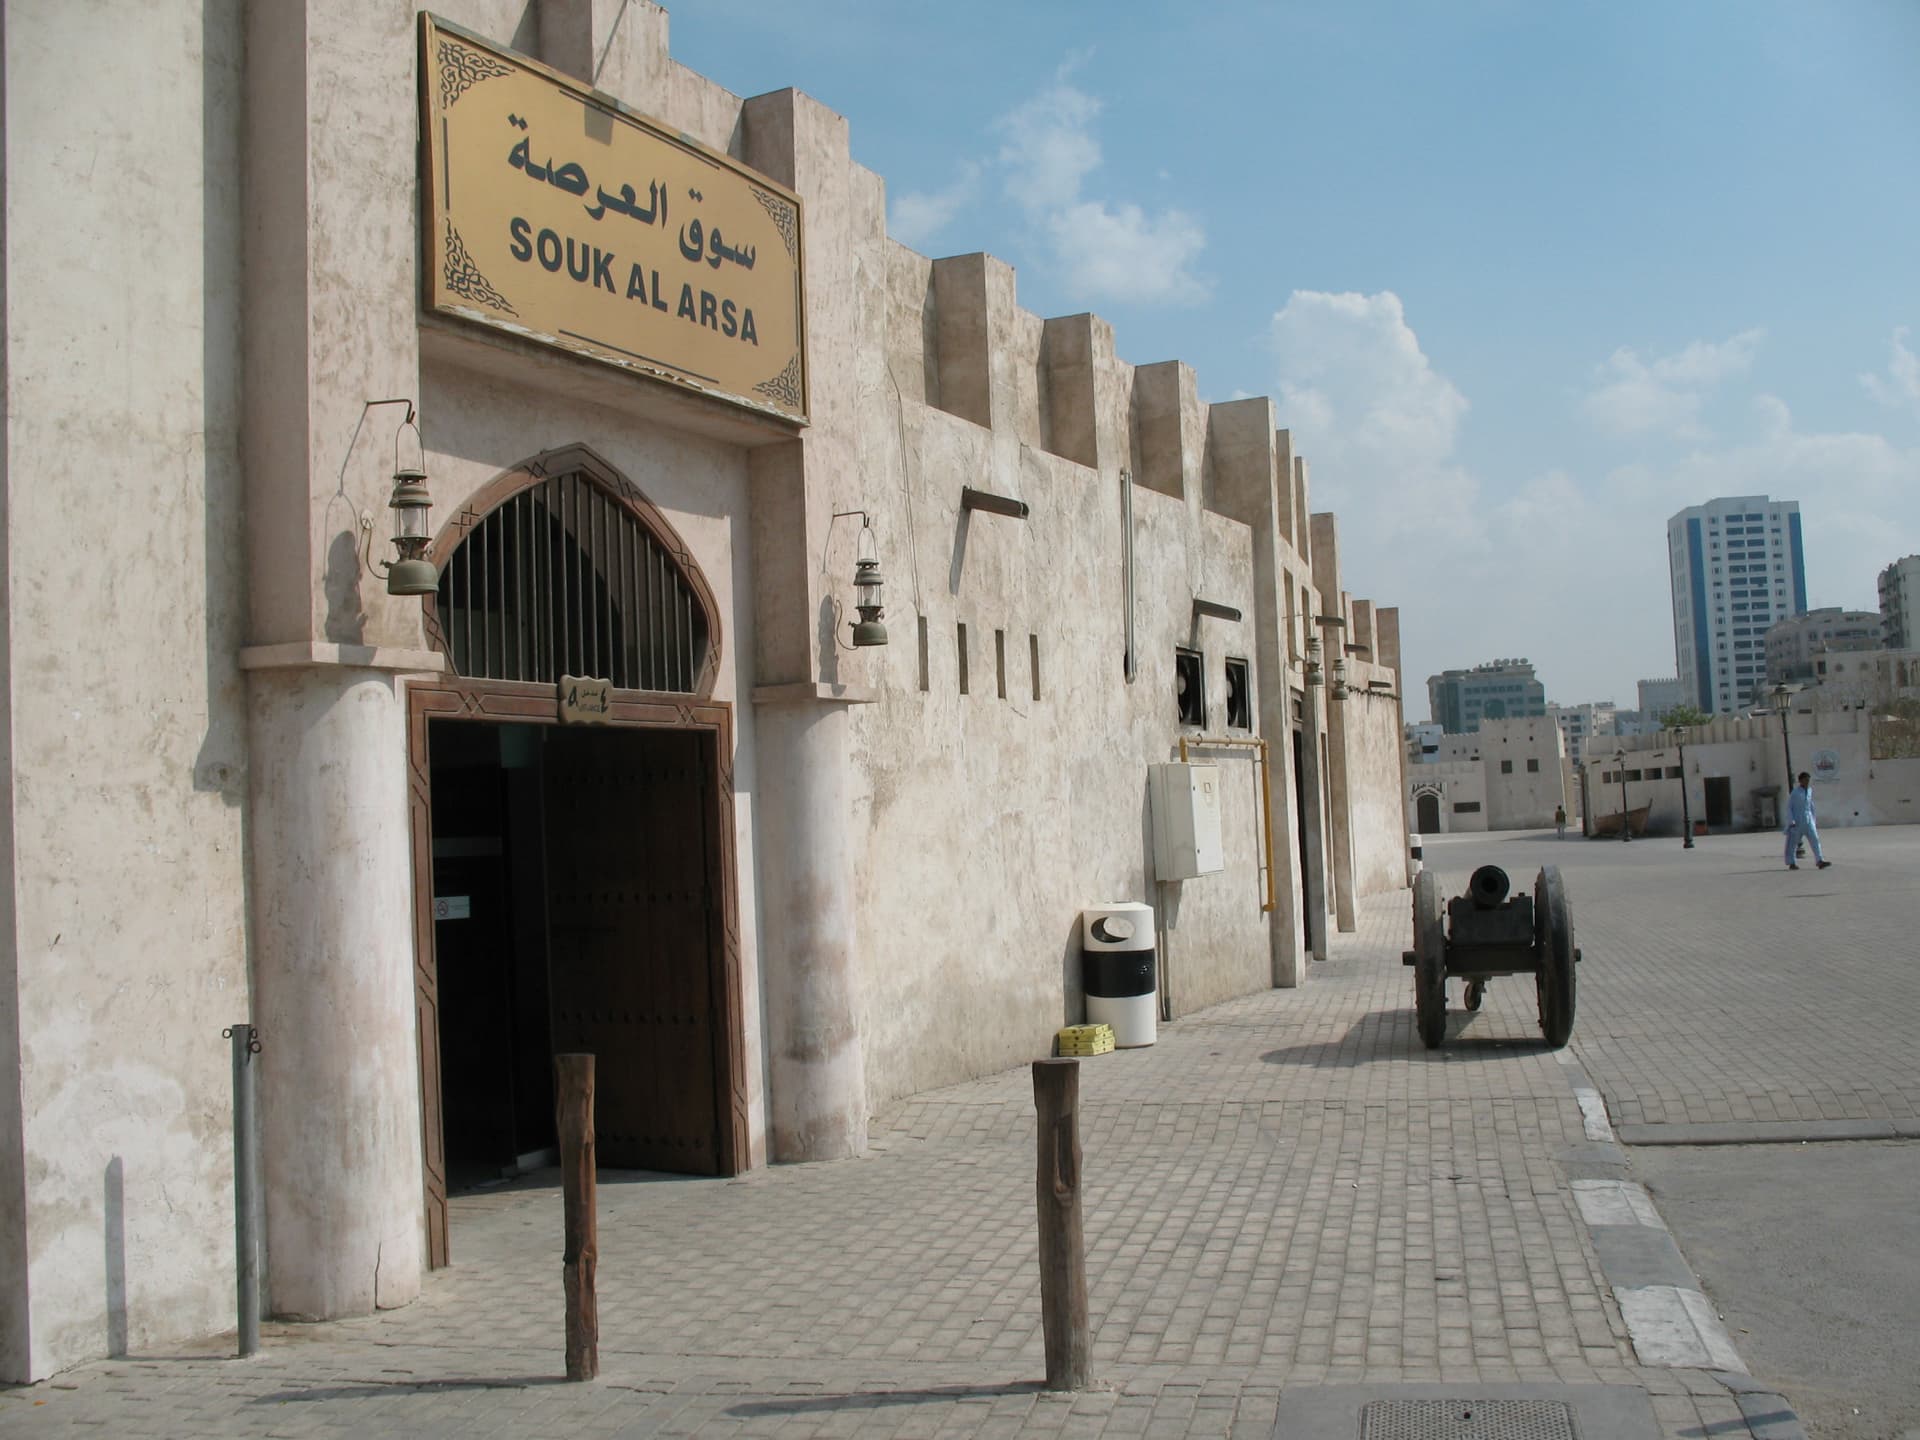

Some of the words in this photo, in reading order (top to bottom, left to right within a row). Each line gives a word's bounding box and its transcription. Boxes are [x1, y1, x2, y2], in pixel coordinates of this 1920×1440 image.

[507, 113, 668, 229] العرصة
[509, 217, 617, 295] SOUK
[626, 263, 668, 313] AL
[677, 283, 759, 347] ARSA
[678, 188, 756, 271] سوق
